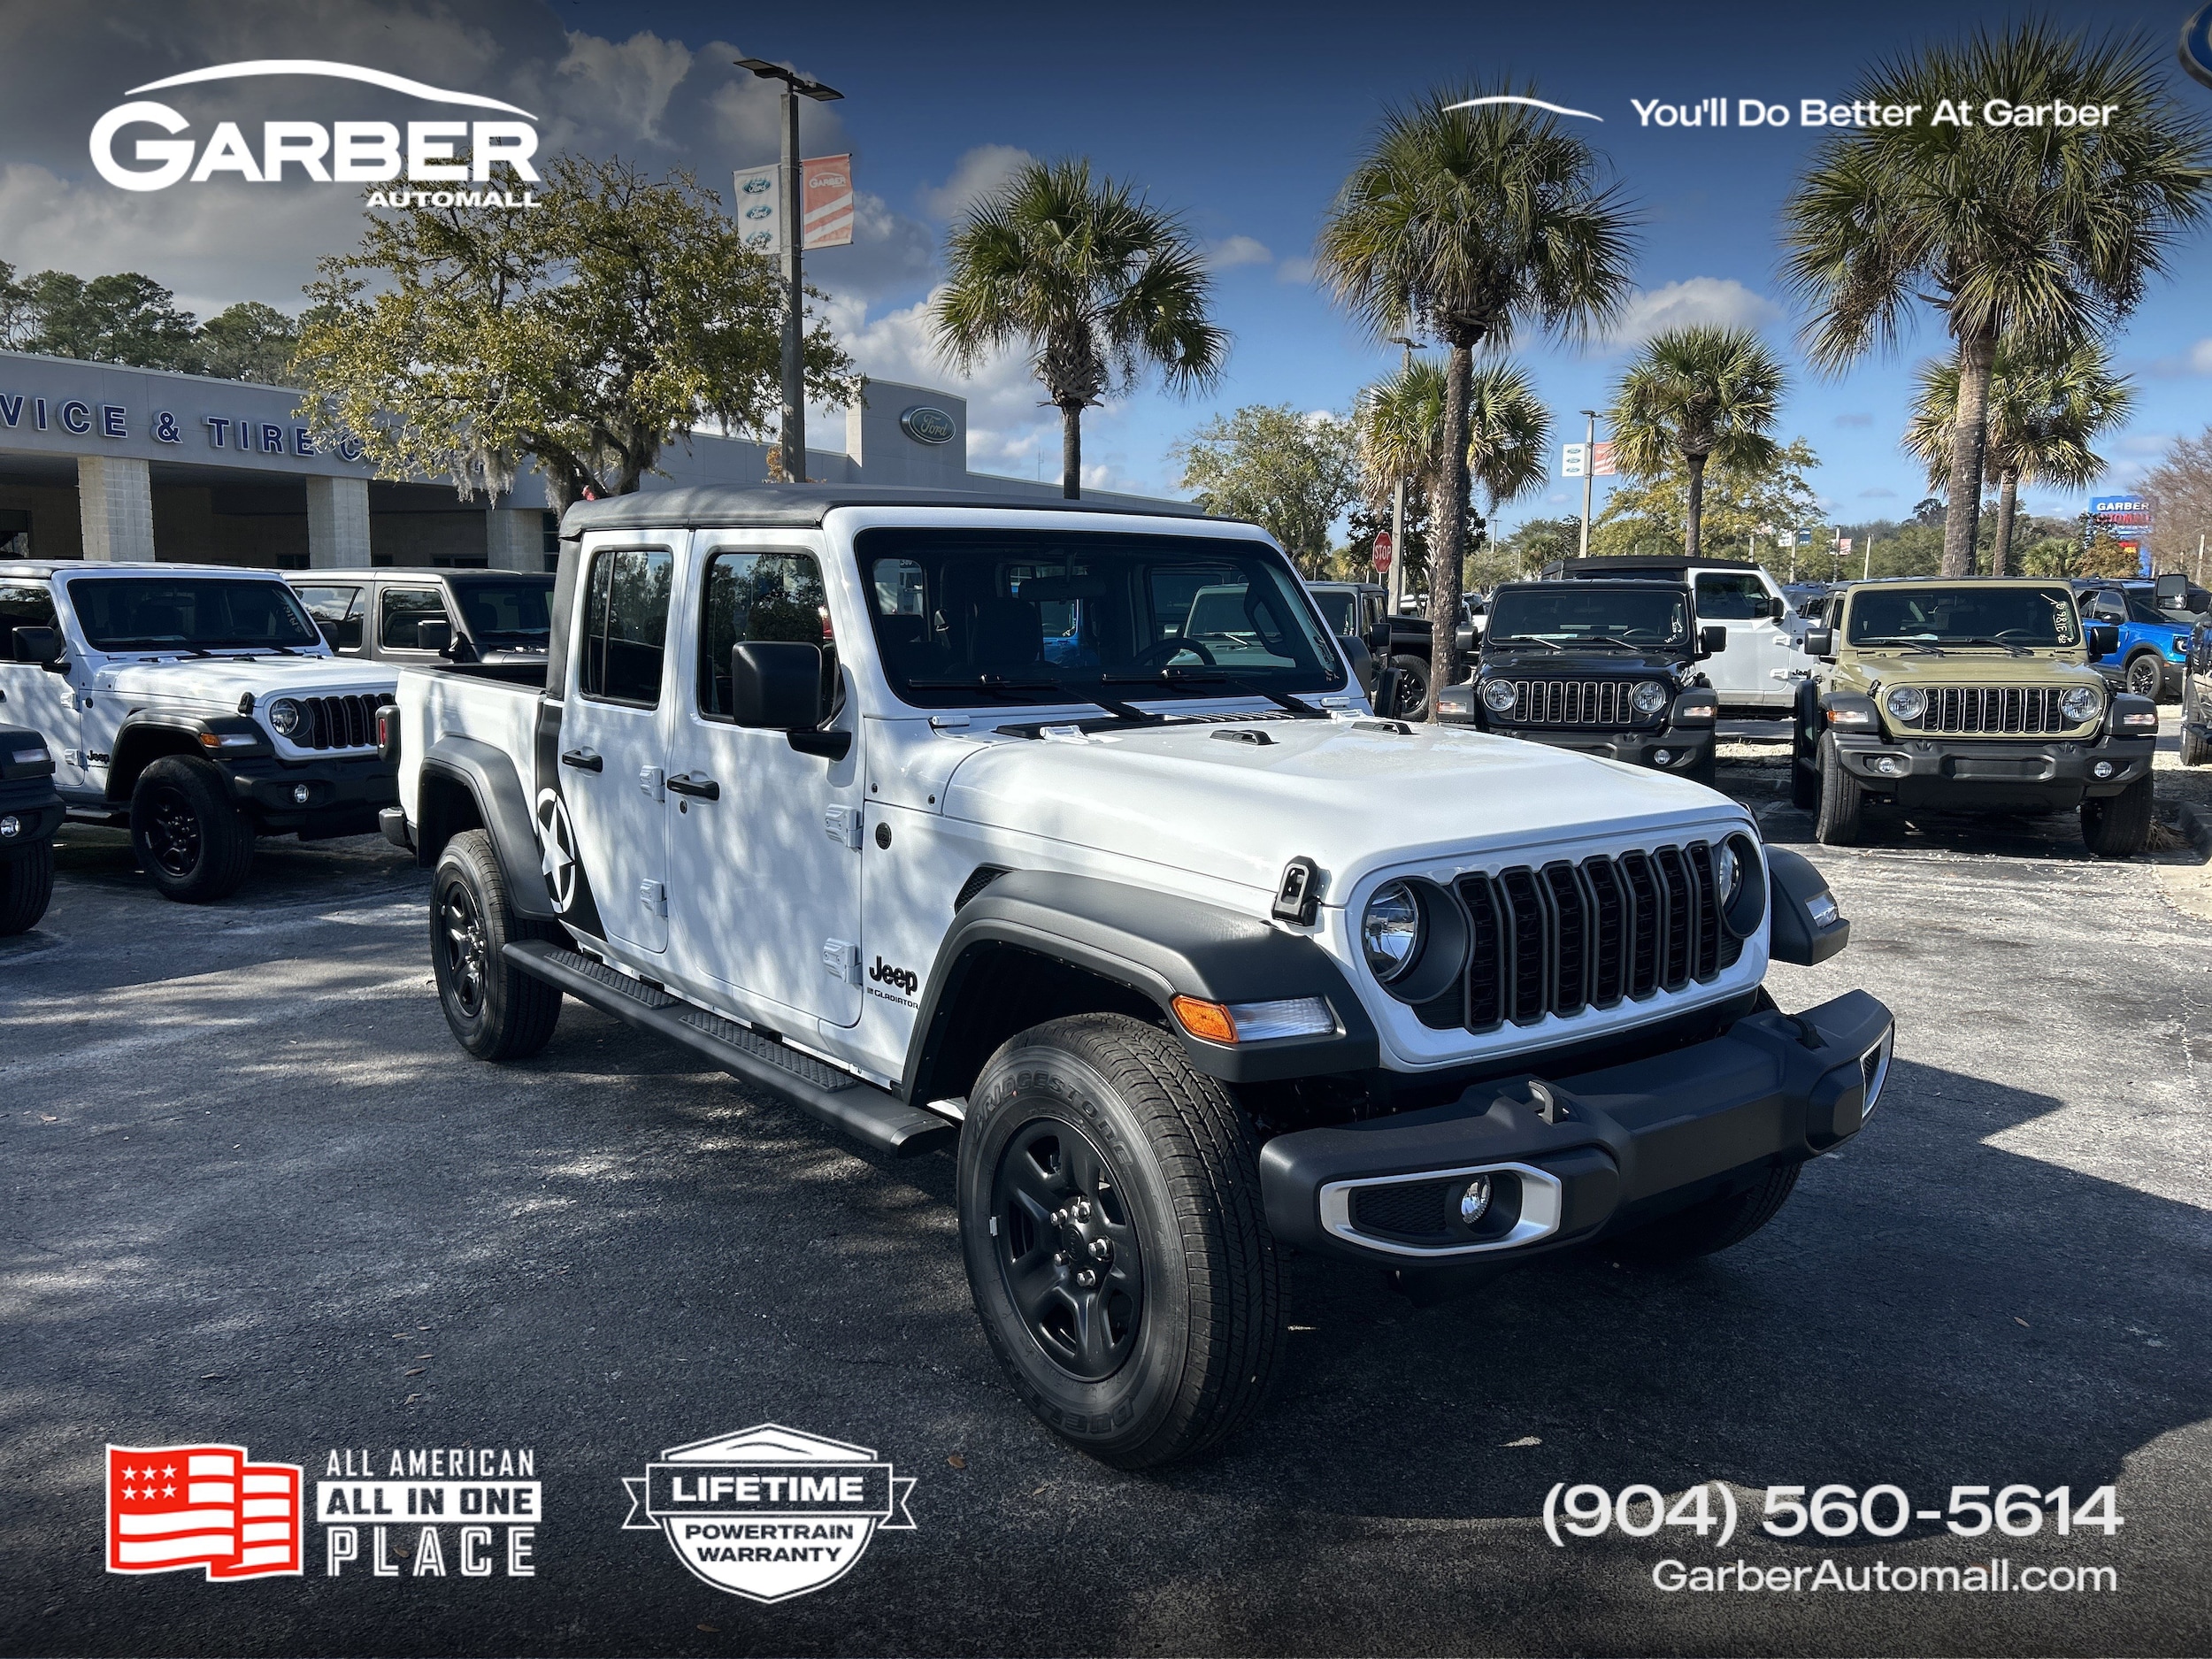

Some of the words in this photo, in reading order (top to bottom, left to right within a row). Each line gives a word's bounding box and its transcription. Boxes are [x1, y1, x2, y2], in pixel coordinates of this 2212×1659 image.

[809, 177, 847, 188] GARBER
[154, 411, 183, 443] &
[204, 416, 317, 457] TIRE
[920, 414, 949, 436] Ford
[2096, 502, 2150, 511] GARBER
[1374, 545, 1392, 561] STOP
[87, 750, 110, 764] Jeep
[869, 956, 918, 996] Jeep
[874, 989, 918, 1010] GLADIATOR
